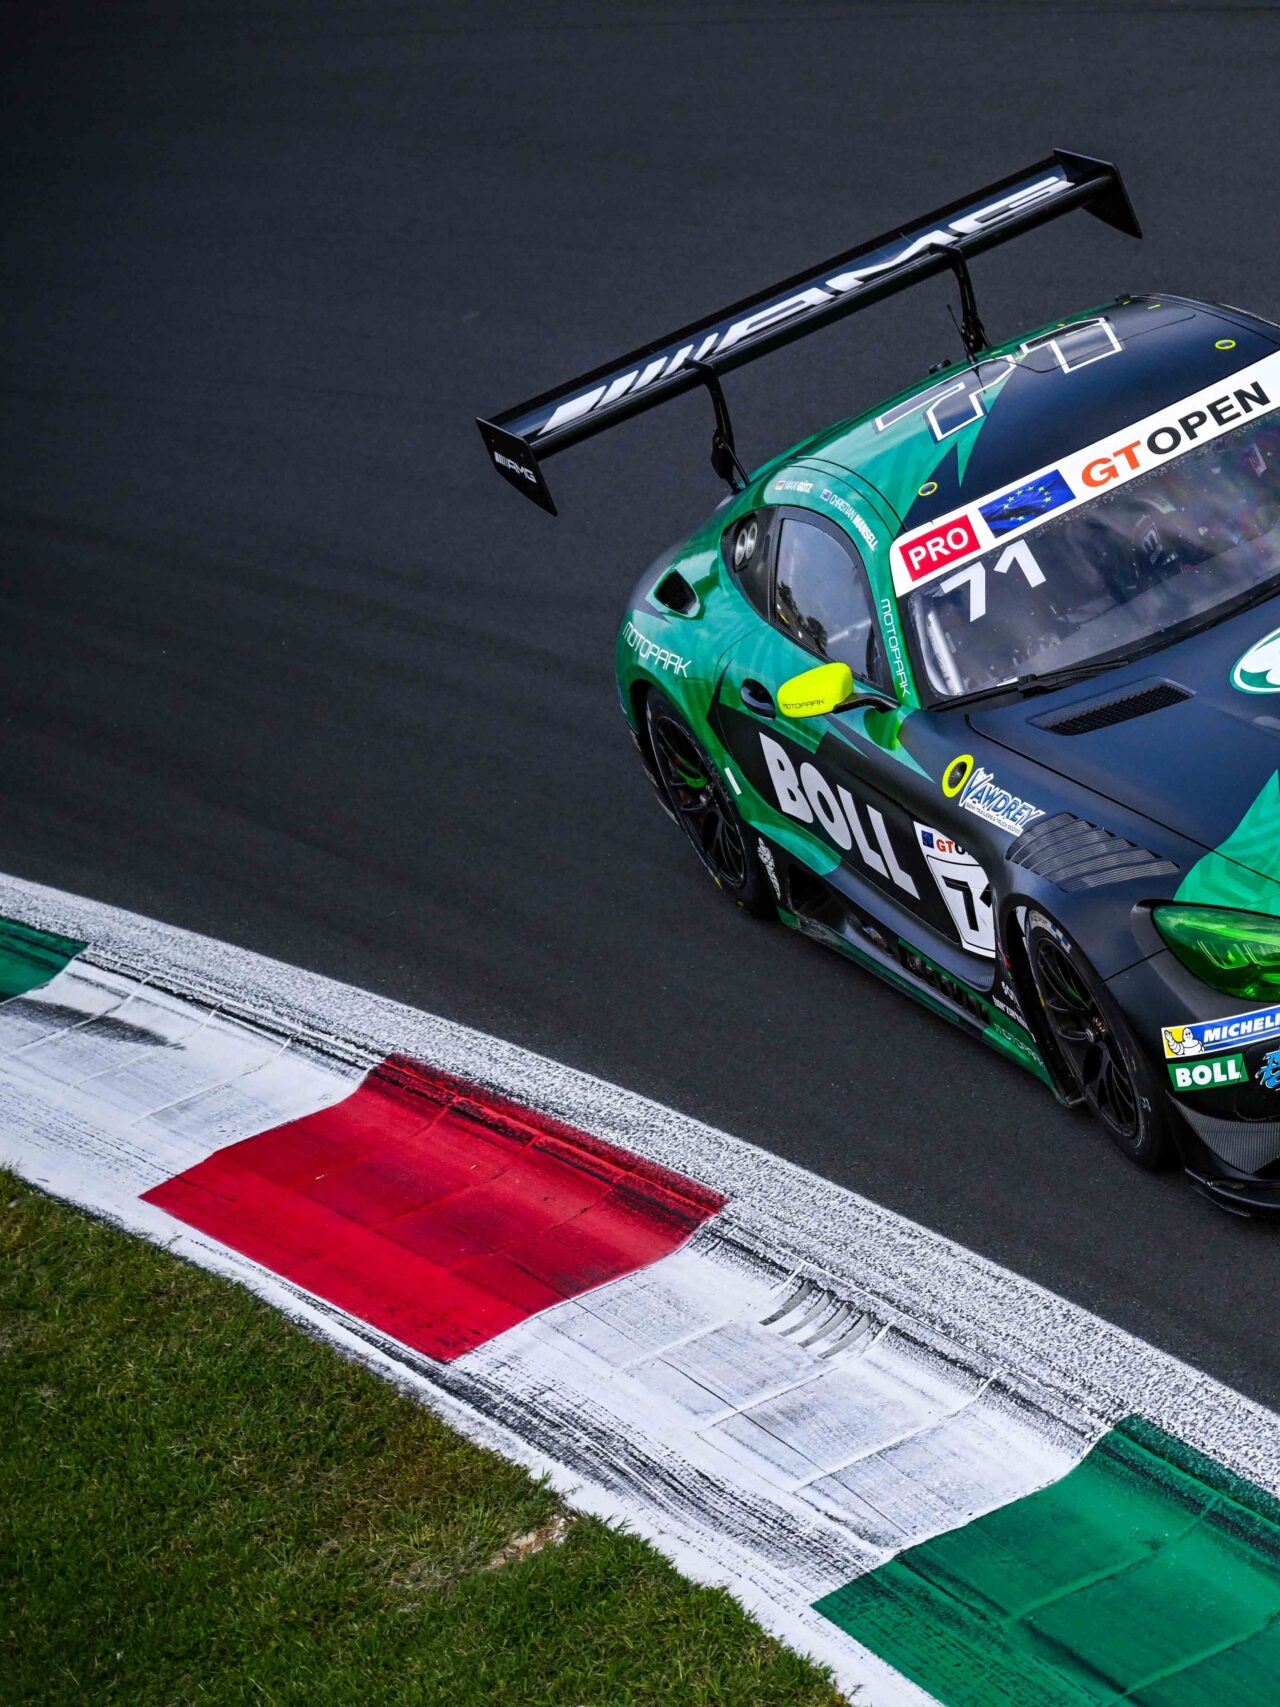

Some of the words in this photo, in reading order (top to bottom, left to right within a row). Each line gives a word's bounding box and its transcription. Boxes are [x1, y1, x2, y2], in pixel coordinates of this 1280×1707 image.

[852, 513, 879, 551] MANSELL
[908, 527, 969, 571] PRO
[940, 538, 1047, 623] 71
[622, 621, 692, 679] MOTOPARK
[882, 598, 911, 698] MOTOPARK
[758, 732, 921, 900] BOLL
[959, 767, 1046, 828] VAWDREY
[1175, 1059, 1242, 1088] BOLL
